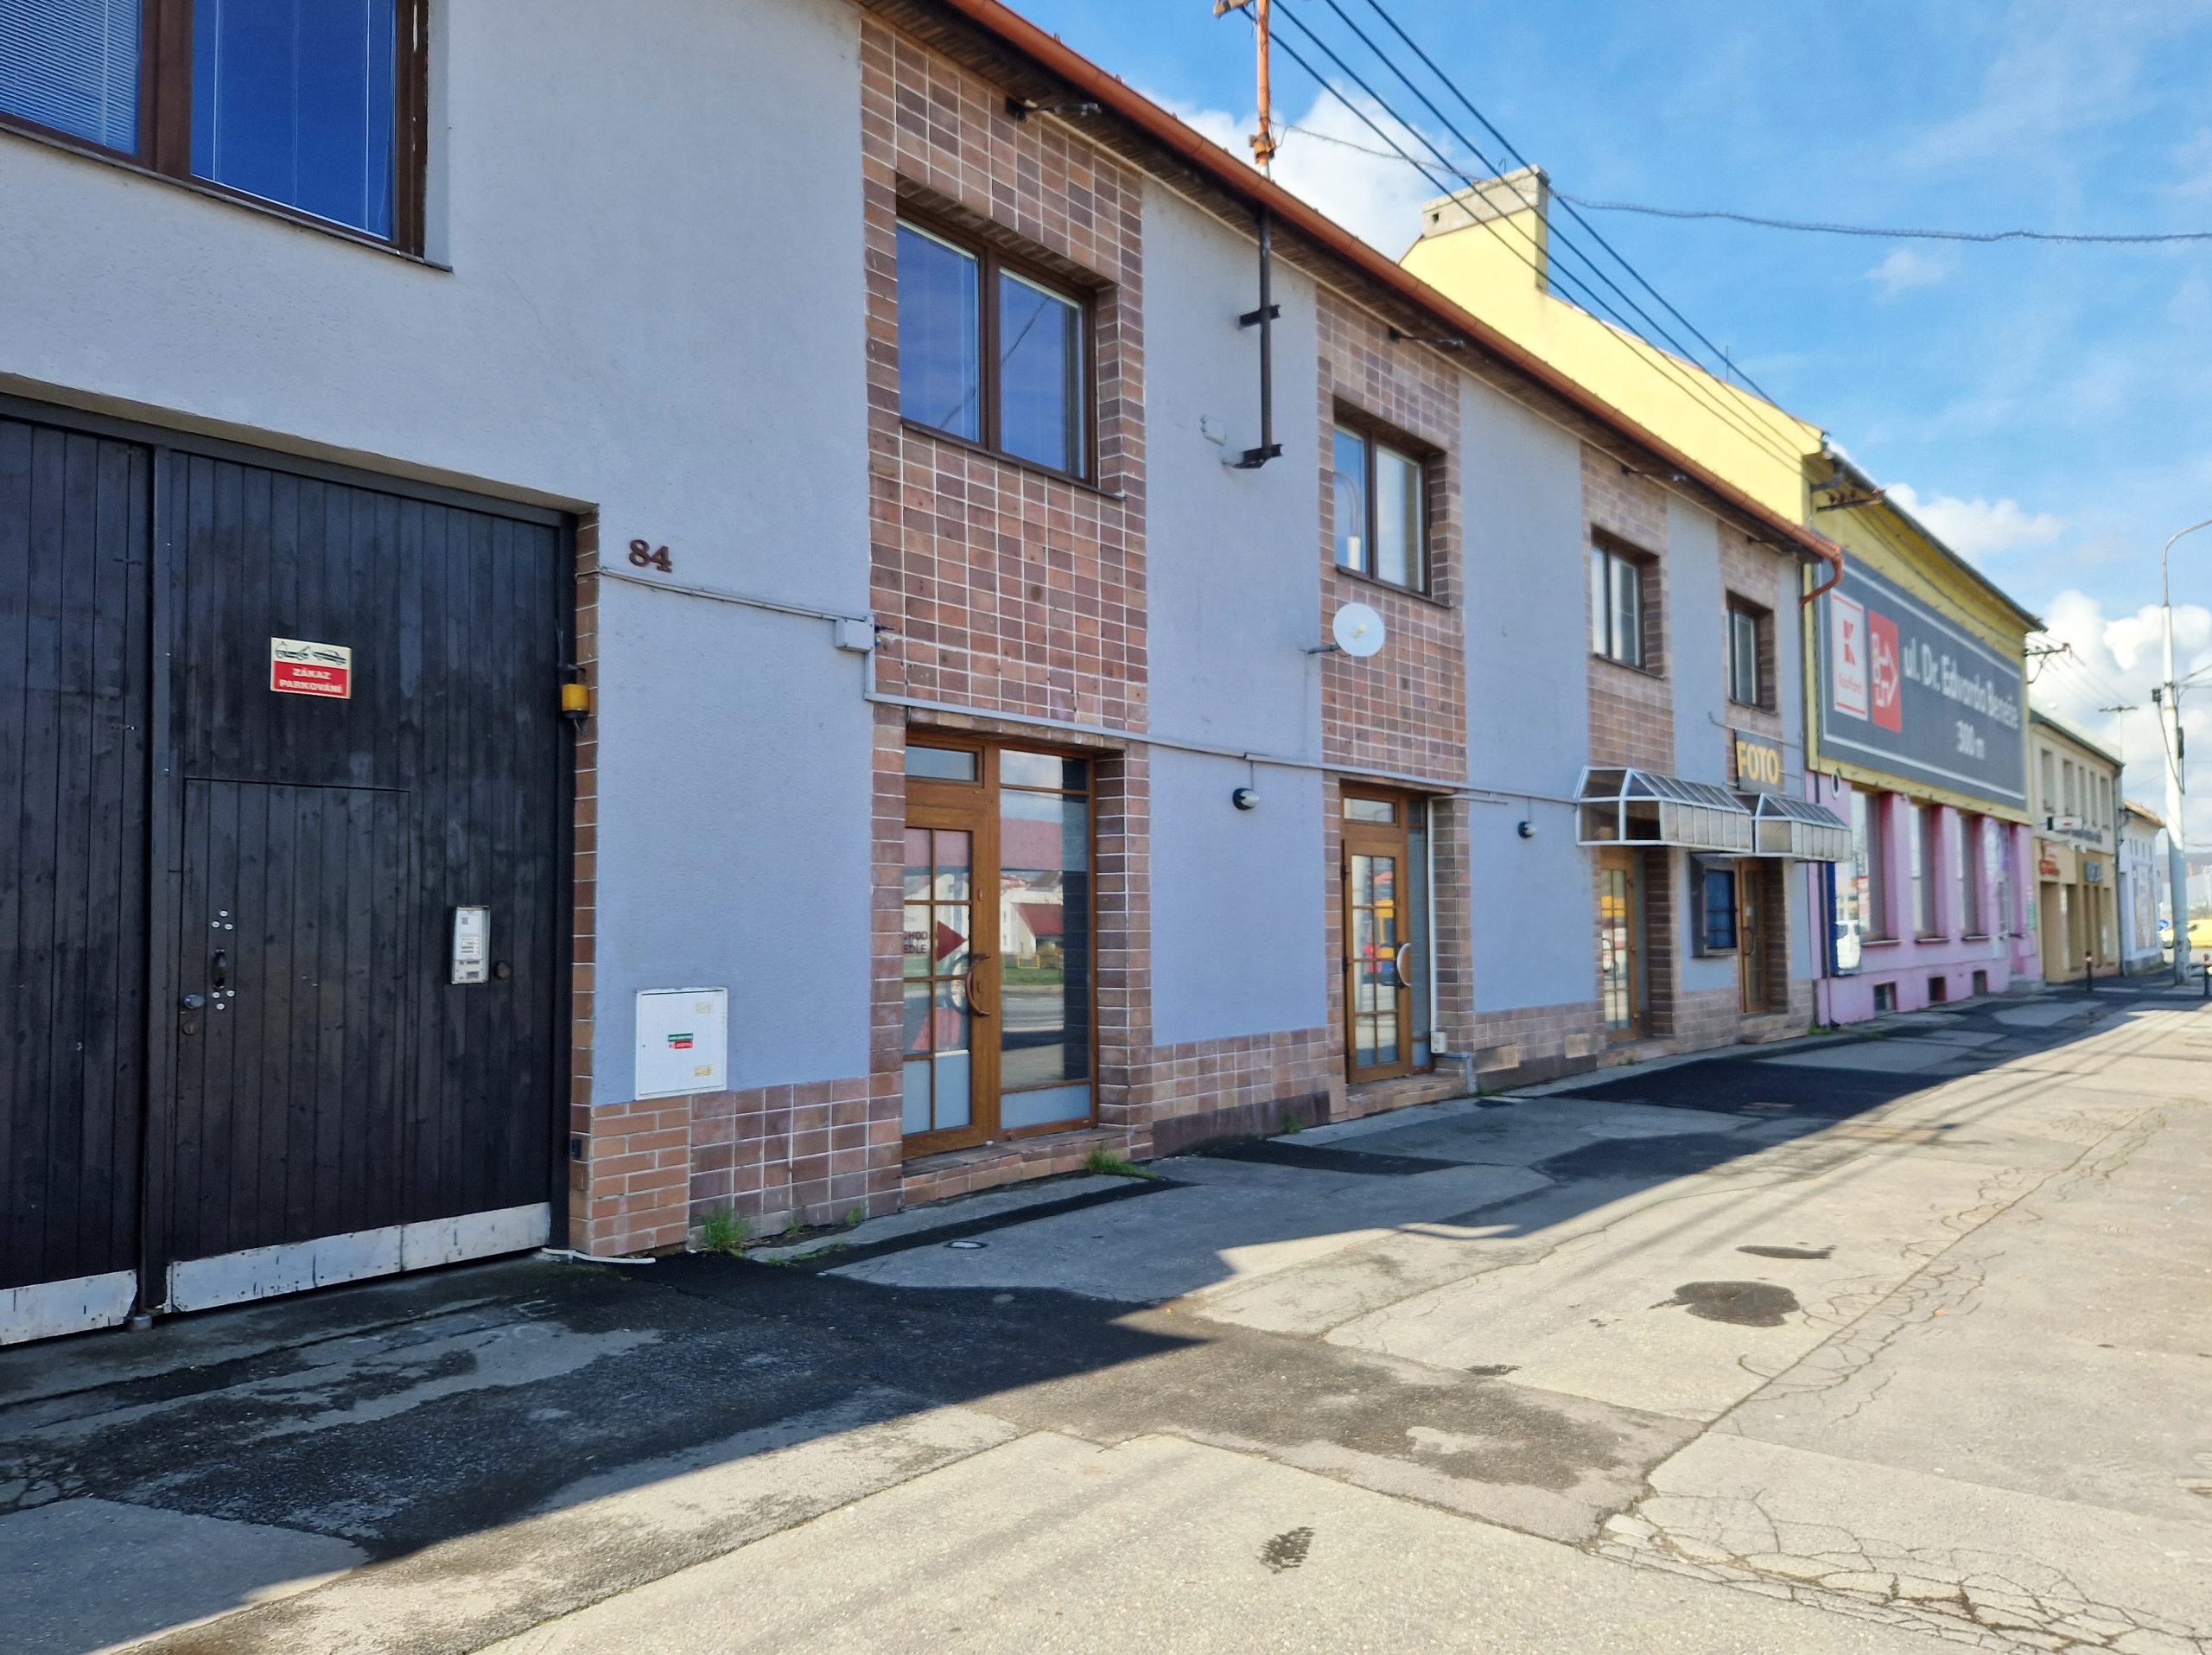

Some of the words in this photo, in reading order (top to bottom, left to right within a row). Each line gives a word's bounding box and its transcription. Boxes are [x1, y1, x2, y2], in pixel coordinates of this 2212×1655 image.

[629, 539, 672, 573] 84
[292, 666, 332, 680] ZÁKAZ
[1903, 636, 1920, 681] ul.
[1922, 642, 1941, 691] Dr.
[278, 678, 344, 694] PARKOVÁNÍ
[1736, 741, 1780, 785] FOTO
[903, 944, 927, 954] EDLE
